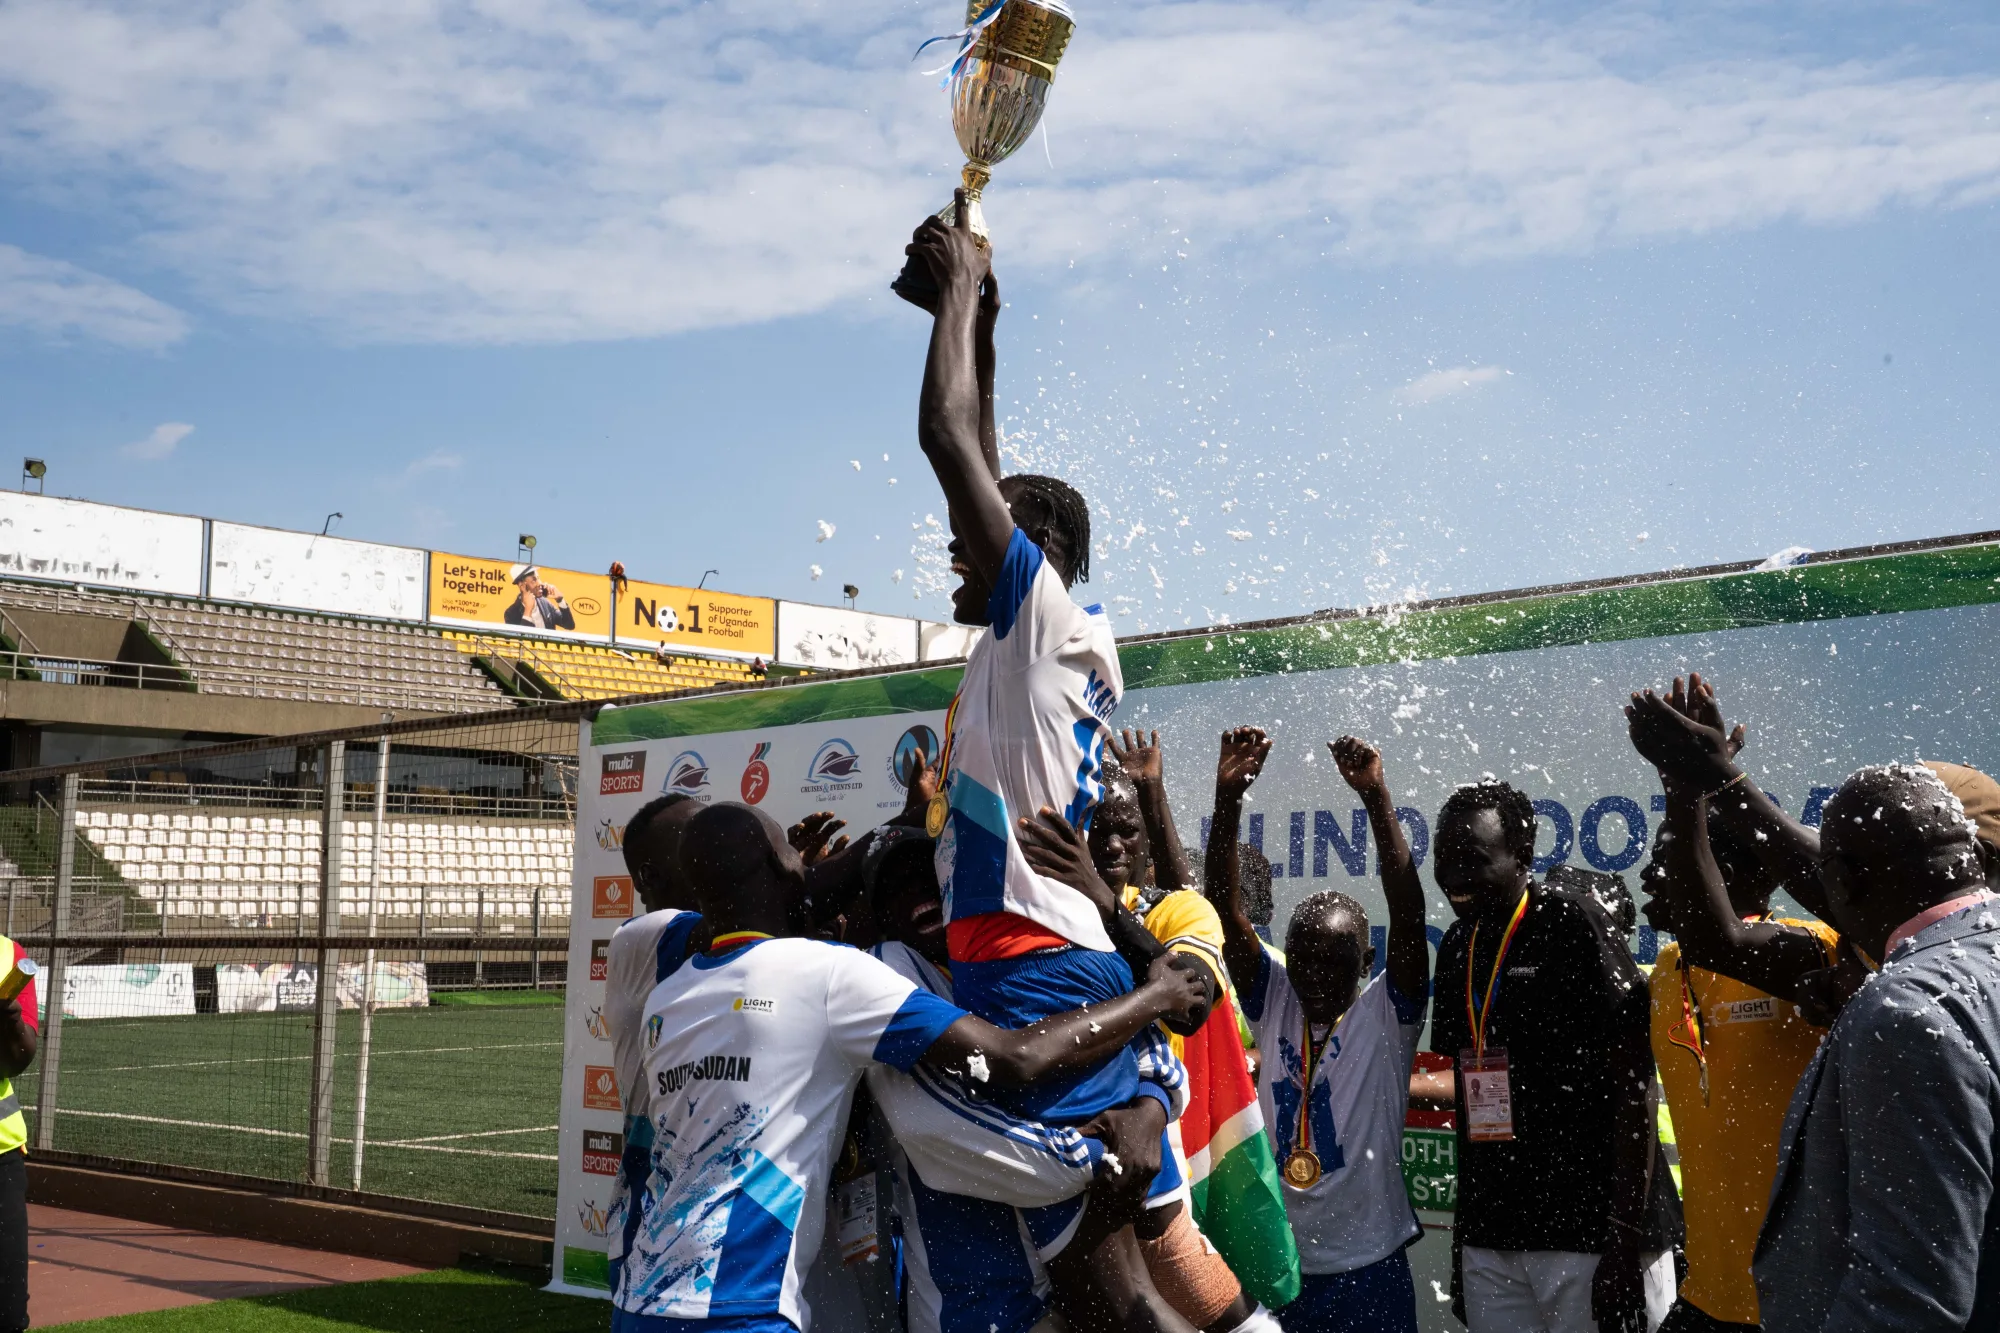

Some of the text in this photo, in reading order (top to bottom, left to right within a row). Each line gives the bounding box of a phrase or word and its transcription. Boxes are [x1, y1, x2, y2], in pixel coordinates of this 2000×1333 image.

[444, 563, 506, 582] Let's talk
[443, 577, 503, 595] together
[578, 602, 594, 611] MTN
[708, 603, 752, 616] Supporter
[708, 614, 759, 629] of Ugandan
[708, 626, 744, 638] Football
[608, 755, 634, 771] multi
[601, 774, 641, 792] SPORTS
[829, 783, 852, 791] EVENTS
[851, 782, 863, 790] LTD
[743, 998, 774, 1009] LIGHT
[1731, 1000, 1771, 1014] LIGHT
[657, 1055, 751, 1096] SOUTH SUDAN
[589, 1135, 612, 1151] multi
[584, 1154, 620, 1173] SPORTS
